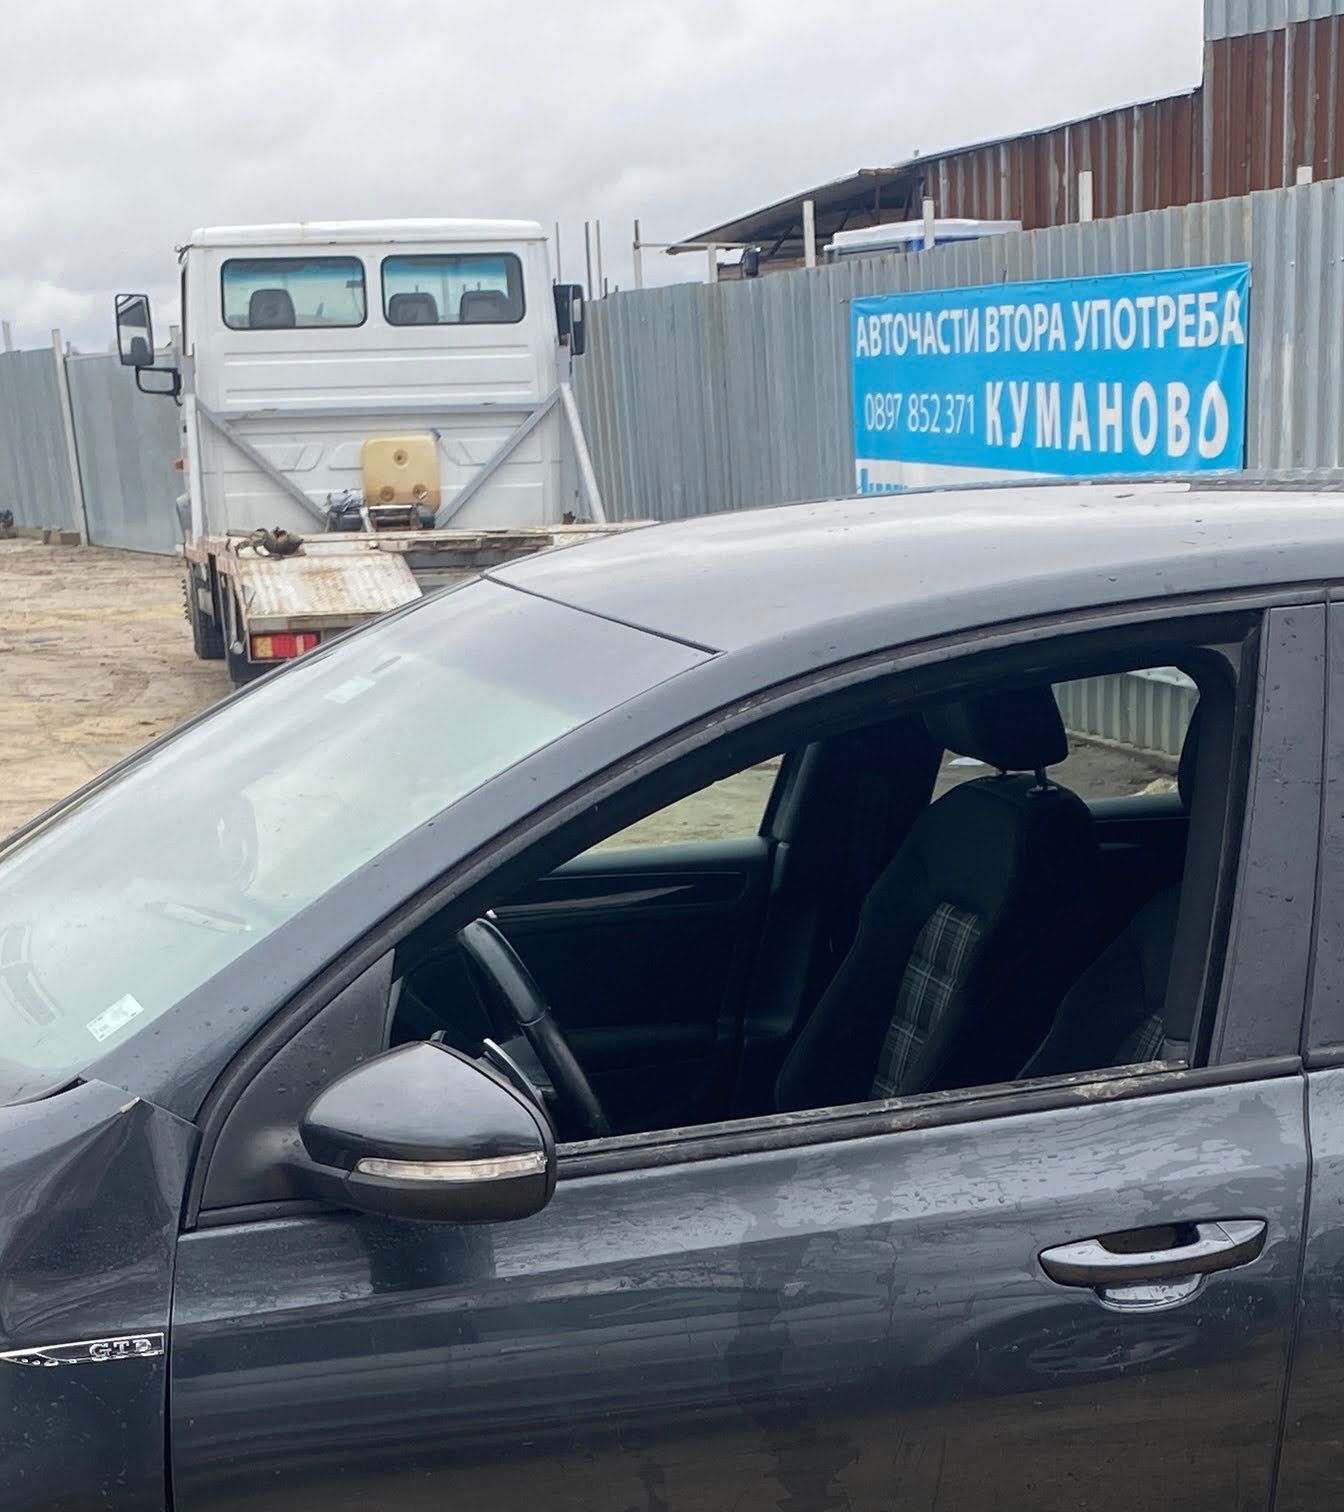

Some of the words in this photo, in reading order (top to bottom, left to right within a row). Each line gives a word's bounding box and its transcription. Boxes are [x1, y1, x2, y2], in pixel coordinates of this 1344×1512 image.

[856, 308, 979, 357] АВТОЧАСТИ
[985, 303, 1067, 352] ВТОРА
[1072, 289, 1244, 351] УПОТРЕБА
[864, 393, 903, 431] 0897
[907, 393, 941, 433] 852
[945, 393, 975, 434] 371
[985, 380, 1229, 459] КУМАНОВО
